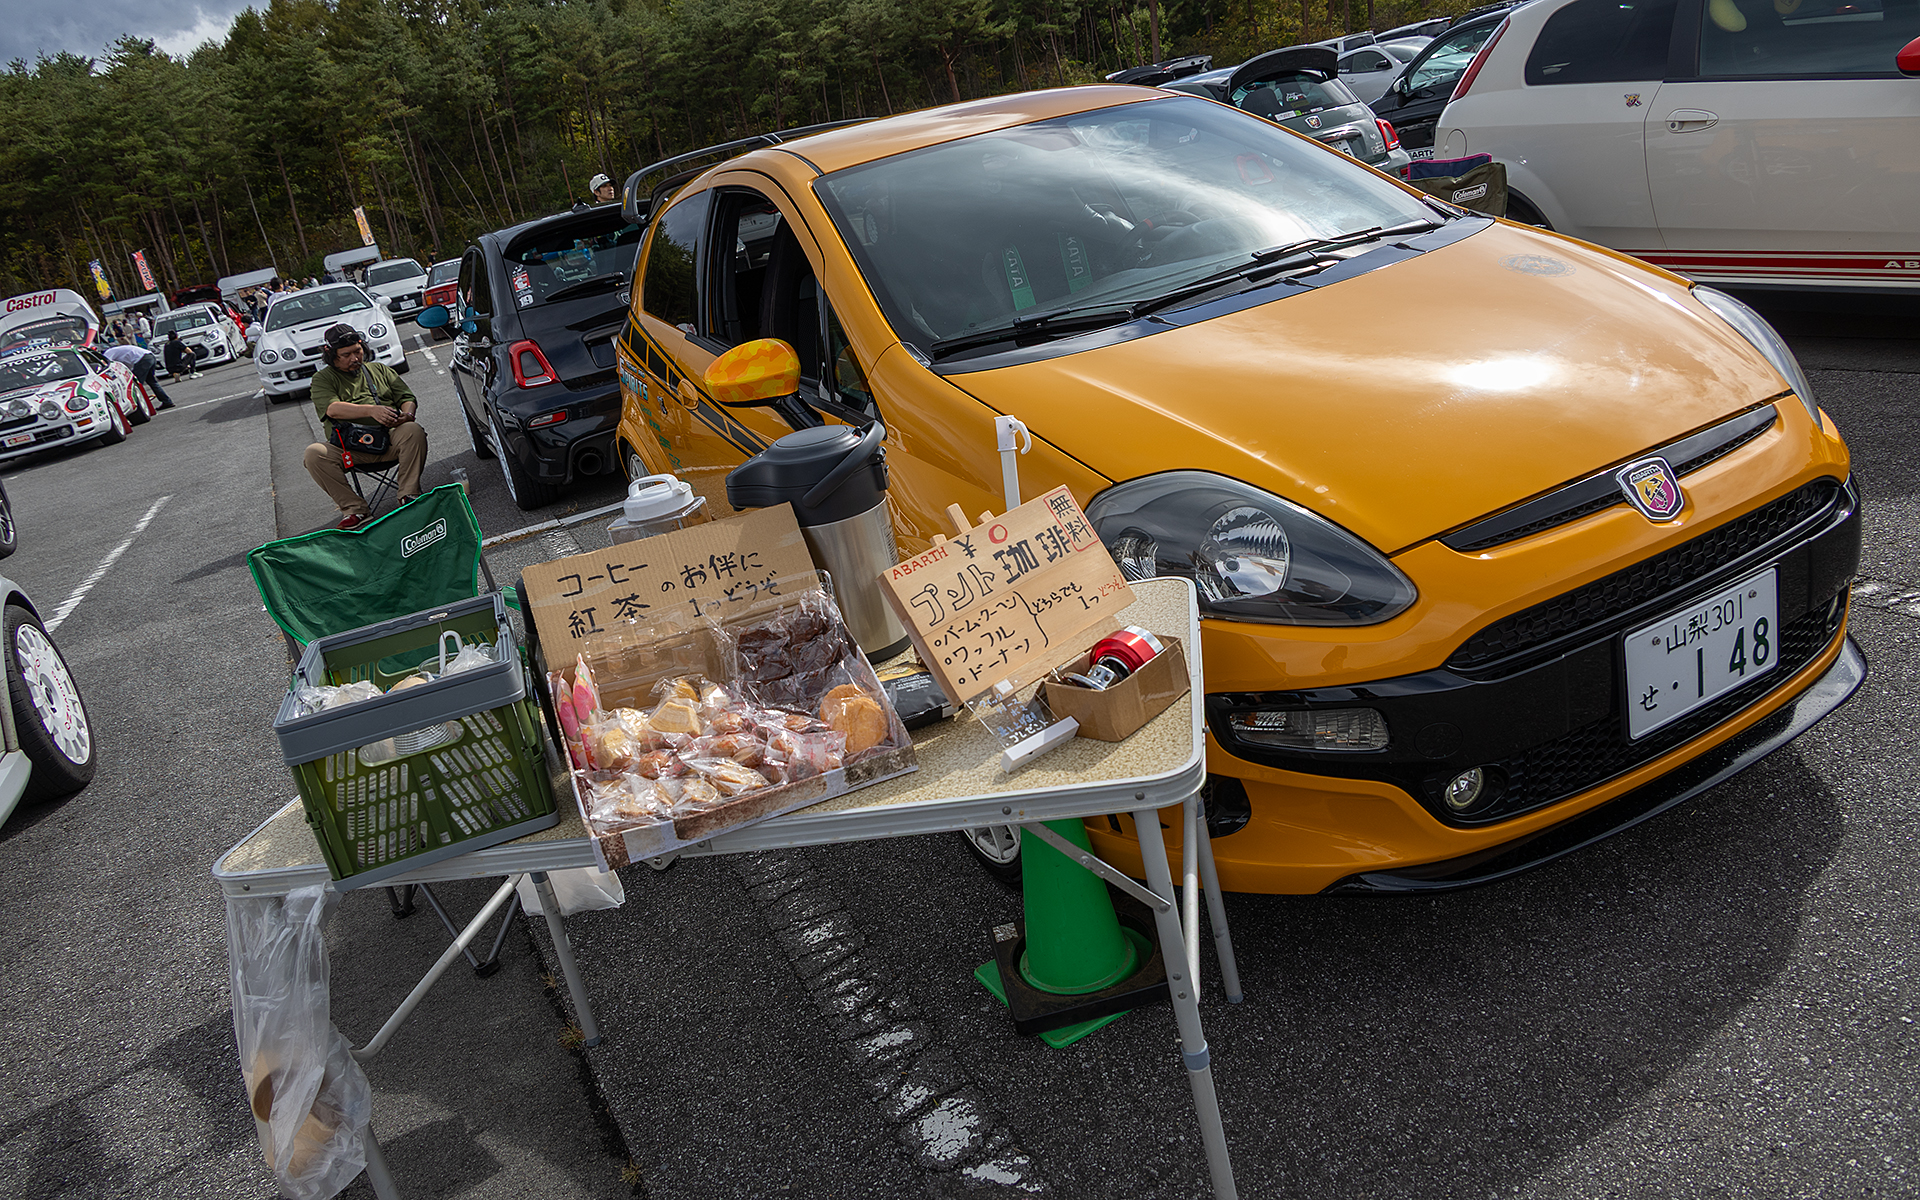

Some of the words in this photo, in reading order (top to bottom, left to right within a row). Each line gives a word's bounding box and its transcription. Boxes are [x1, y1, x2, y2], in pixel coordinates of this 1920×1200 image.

[1455, 187, 1481, 201] Coleman
[6, 291, 57, 313] Castrol
[8, 353, 58, 367] TOYOTA
[1632, 467, 1659, 481] ABARTH
[1050, 494, 1092, 543] 無料
[405, 529, 437, 551] Coleman
[893, 546, 949, 580] ABARTH
[557, 563, 648, 598] コーヒー
[568, 593, 651, 639] 紅茶
[1640, 685, 1659, 711] せ
